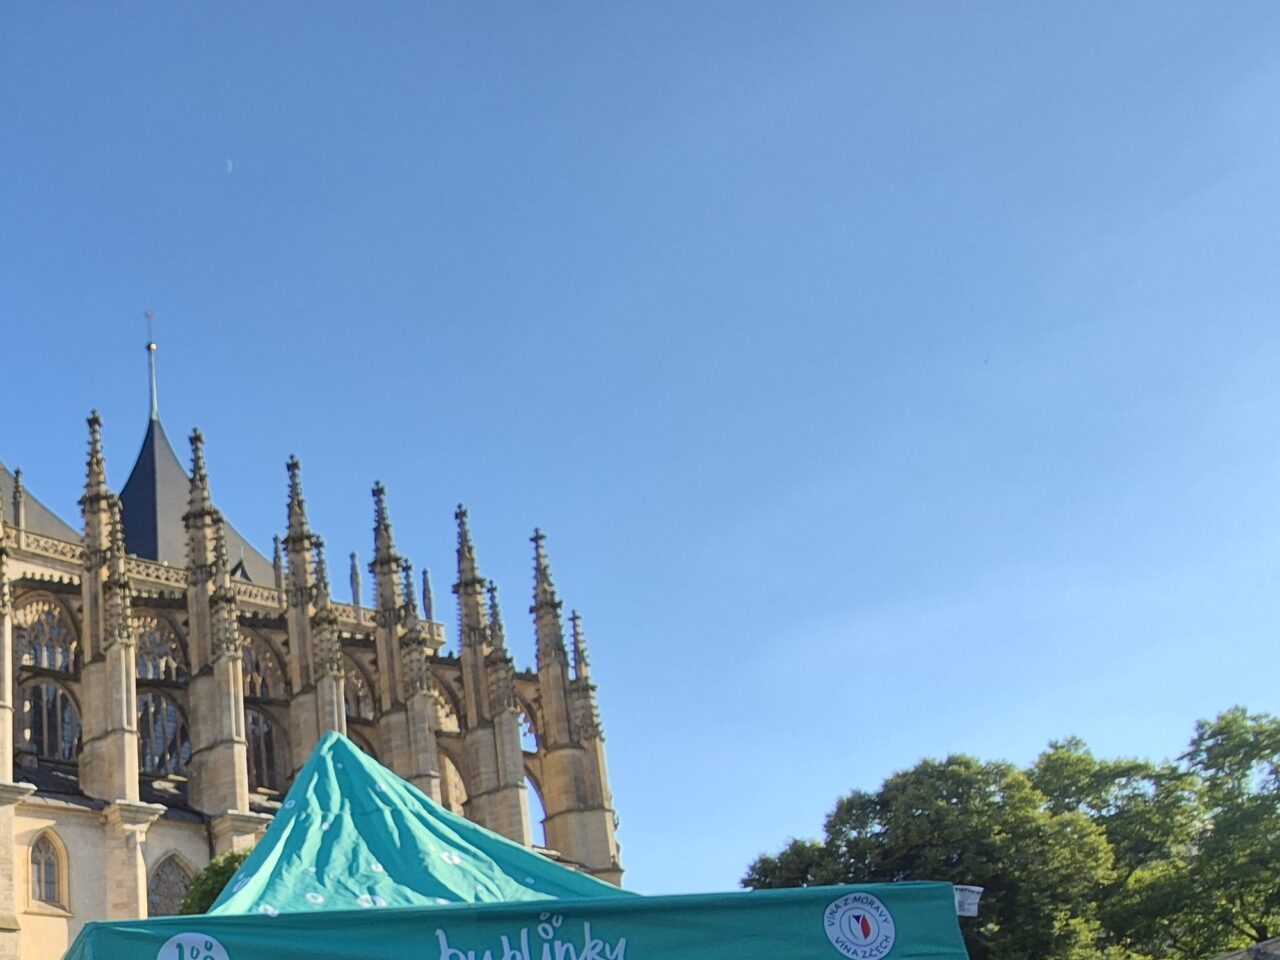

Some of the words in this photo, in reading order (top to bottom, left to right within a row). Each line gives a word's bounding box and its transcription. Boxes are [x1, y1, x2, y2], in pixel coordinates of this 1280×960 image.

[843, 897, 850, 906] Z
[852, 896, 890, 924] MORAVY
[861, 950, 868, 959] Z
